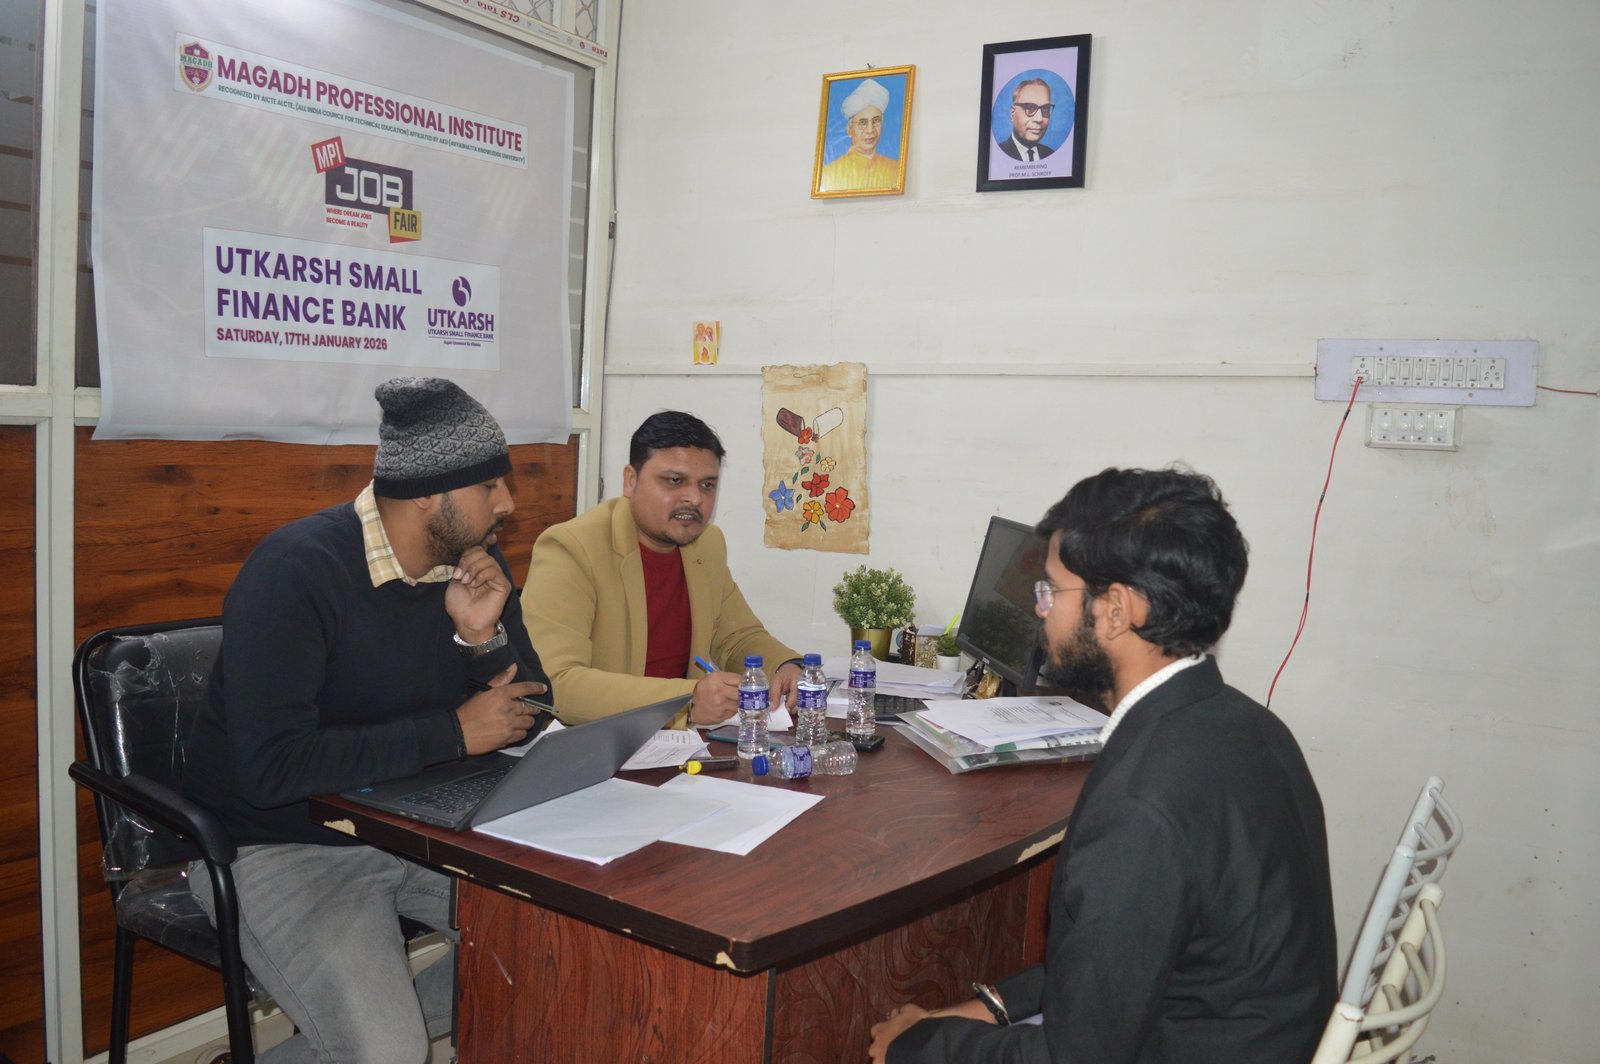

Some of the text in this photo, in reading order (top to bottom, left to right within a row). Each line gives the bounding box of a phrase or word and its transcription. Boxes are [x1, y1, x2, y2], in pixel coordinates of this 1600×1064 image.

[477, 0, 520, 23] CLS Tata
[180, 54, 212, 68] MAGADH
[218, 55, 522, 152] MAGADH PROFESSIONAL INSTITUTE
[218, 84, 252, 99] RECOGNIZED
[308, 106, 321, 115] INDIA
[322, 110, 344, 120] COUNCIL
[355, 118, 380, 129] TECHNICAL
[316, 142, 342, 170] MPI
[336, 166, 404, 208] JOB
[326, 208, 372, 220] WHERE DREAM JOBS
[326, 217, 346, 225] BECOME
[351, 220, 368, 228] REALITY
[394, 212, 418, 233] FAIR
[216, 246, 422, 294] UTKARSH SMALL
[217, 288, 406, 330] FINANCE BANK
[428, 308, 494, 332] UTKARSH
[216, 328, 388, 350] SATURDAY, 17TH JANUARY 2026
